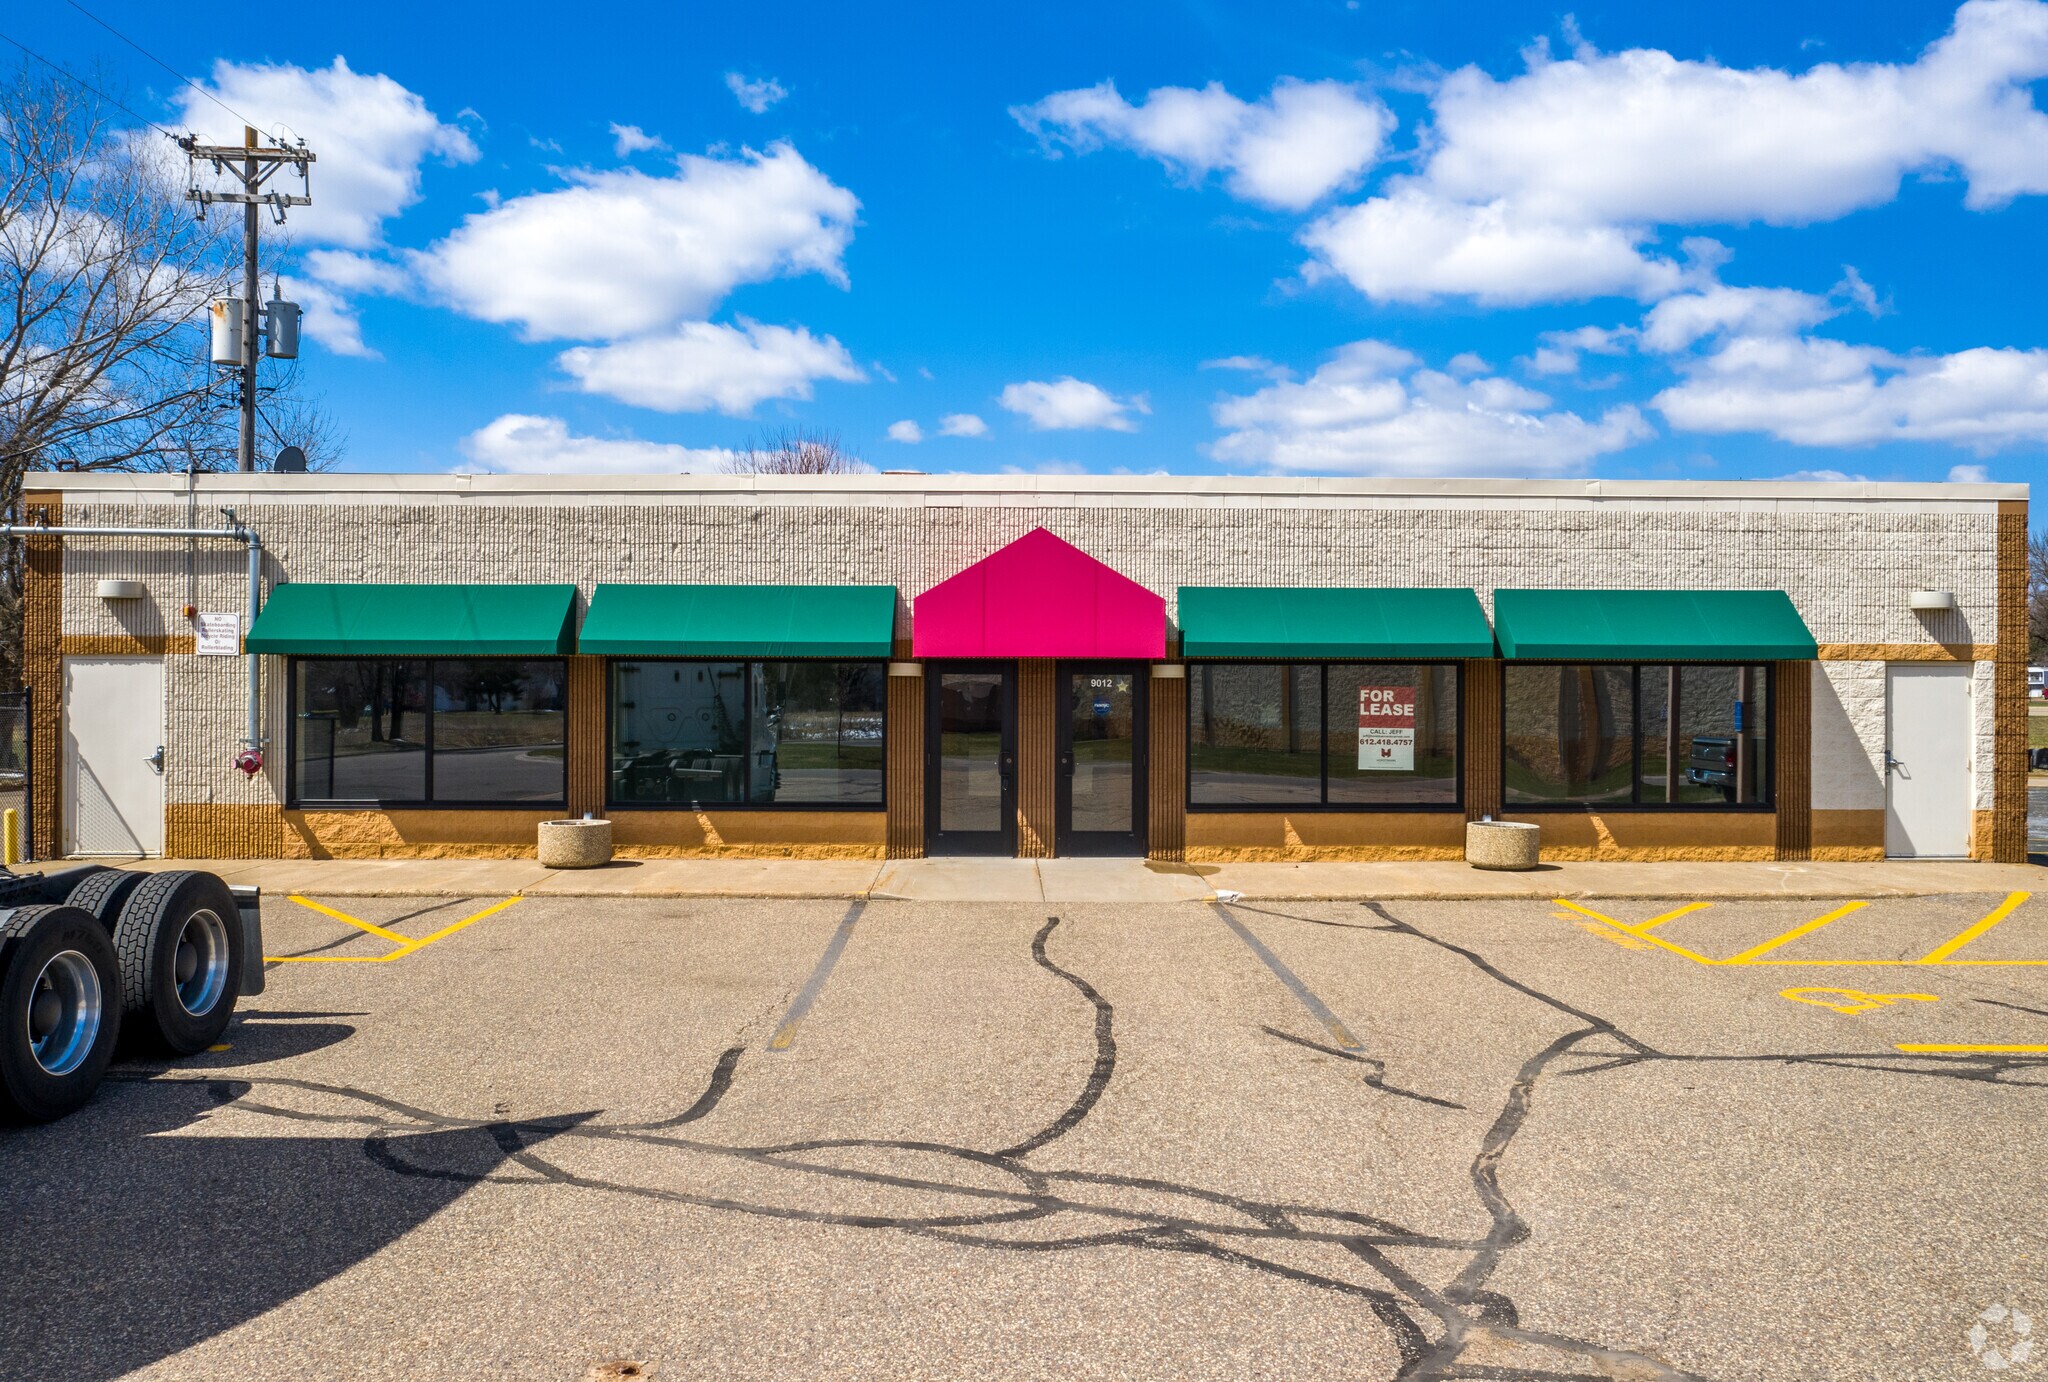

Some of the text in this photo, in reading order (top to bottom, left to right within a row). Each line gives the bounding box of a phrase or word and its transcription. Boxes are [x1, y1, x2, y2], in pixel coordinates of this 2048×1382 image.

[1090, 678, 1113, 688] 9012
[1360, 689, 1395, 702] FOR
[1360, 703, 1414, 716] LEASE
[1359, 738, 1413, 746] 612.418.4757
